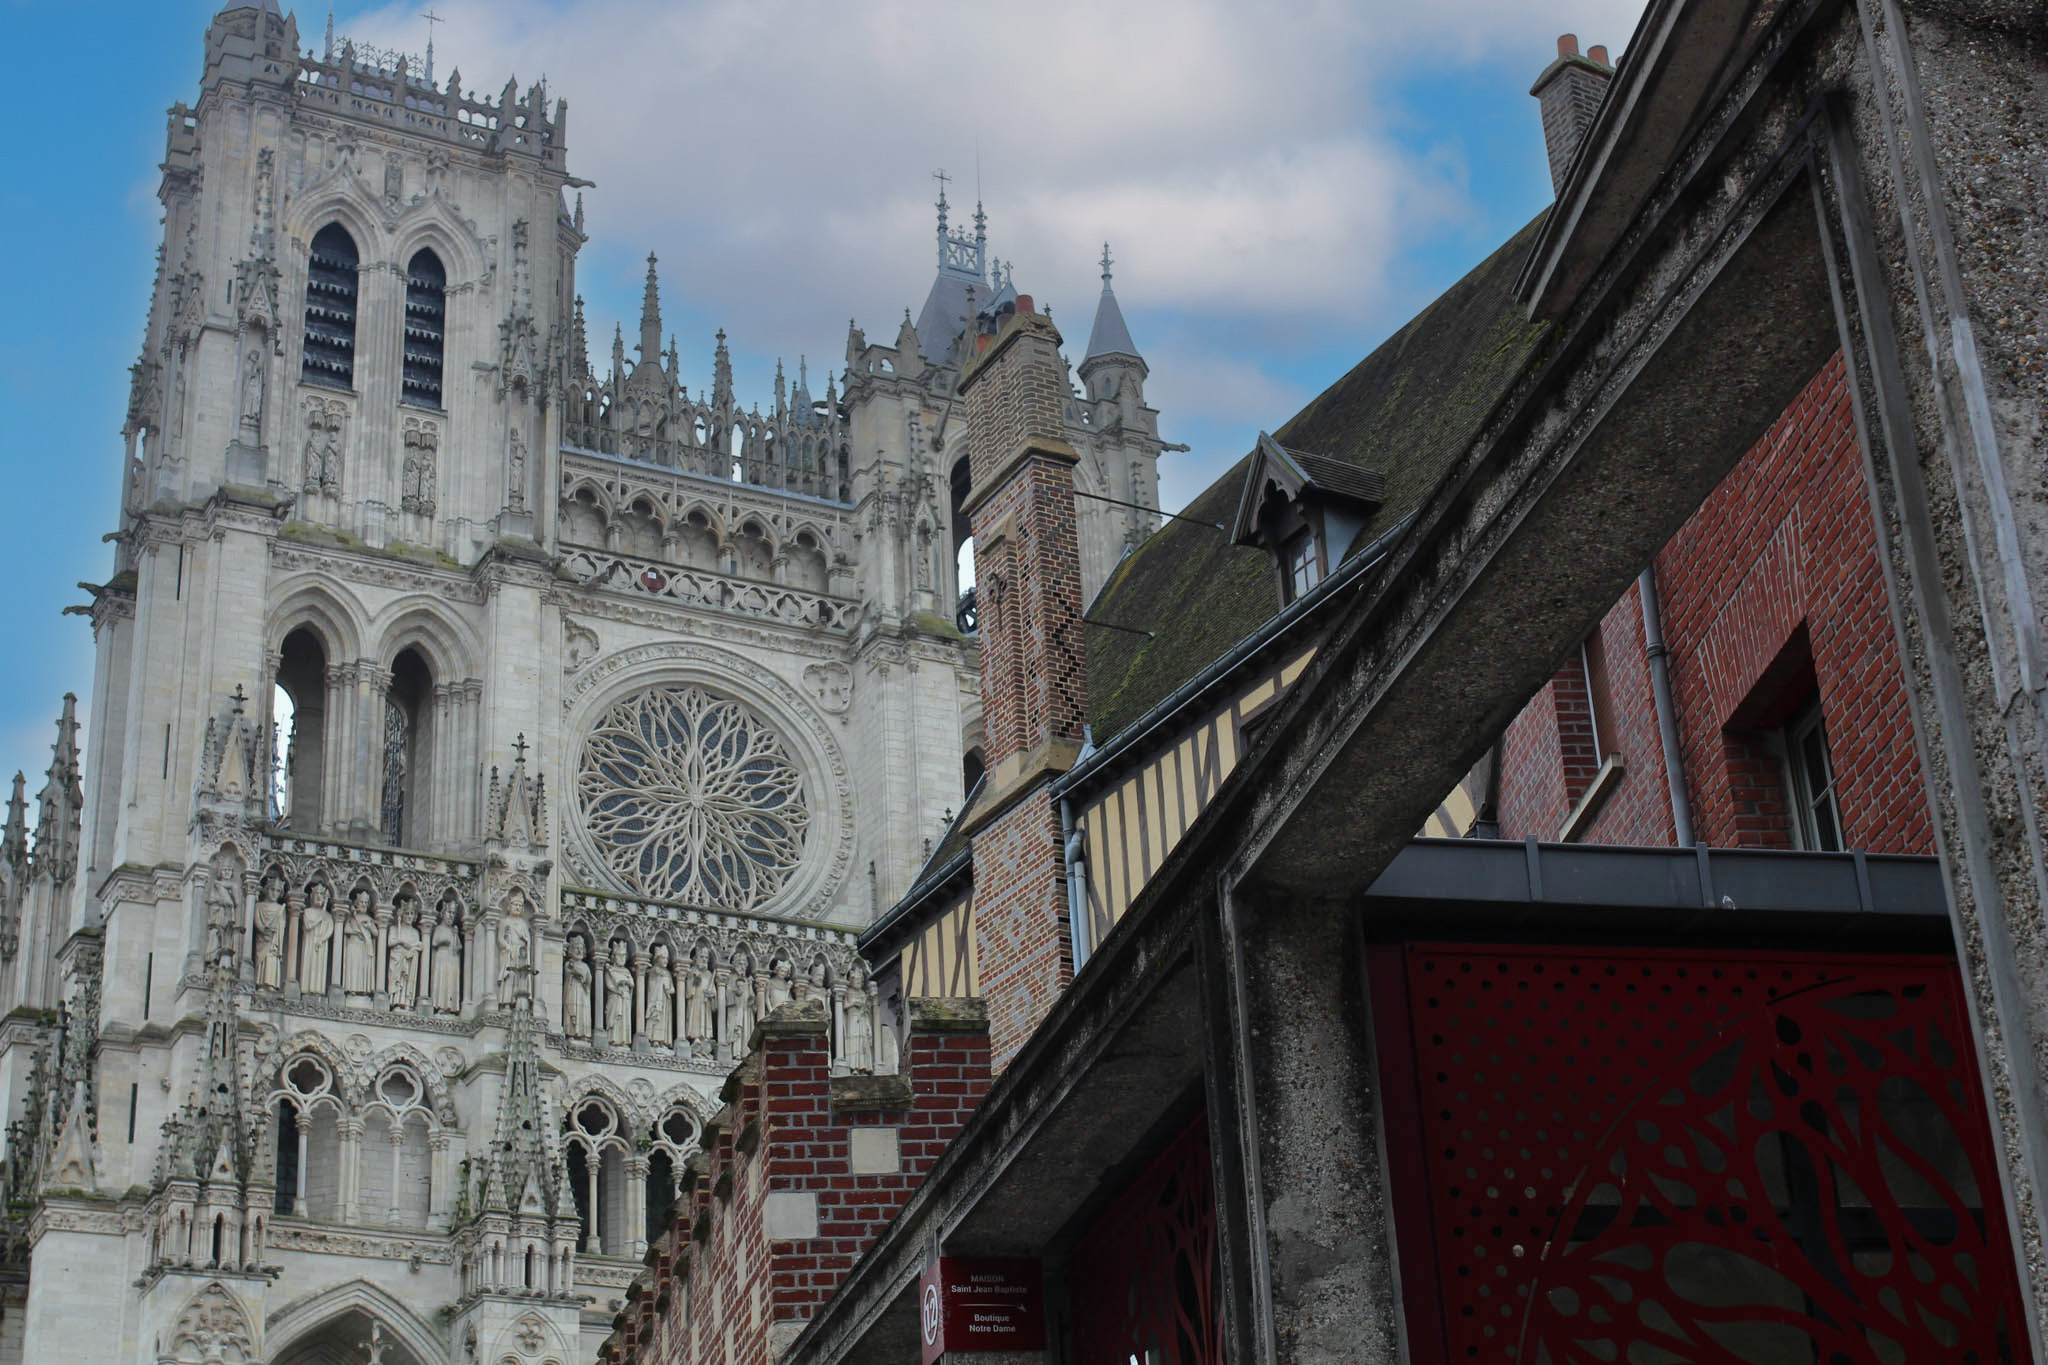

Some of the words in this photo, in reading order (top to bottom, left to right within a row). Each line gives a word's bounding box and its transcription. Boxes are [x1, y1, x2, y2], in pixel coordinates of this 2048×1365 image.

[971, 1274, 1004, 1283] MAISON
[951, 1285, 972, 1293] Saint
[974, 1285, 993, 1293] Jean
[995, 1285, 1027, 1295] Baptiste
[974, 1314, 1009, 1323] Boutique
[969, 1324, 991, 1333] Notre
[993, 1324, 1016, 1333] Dame
